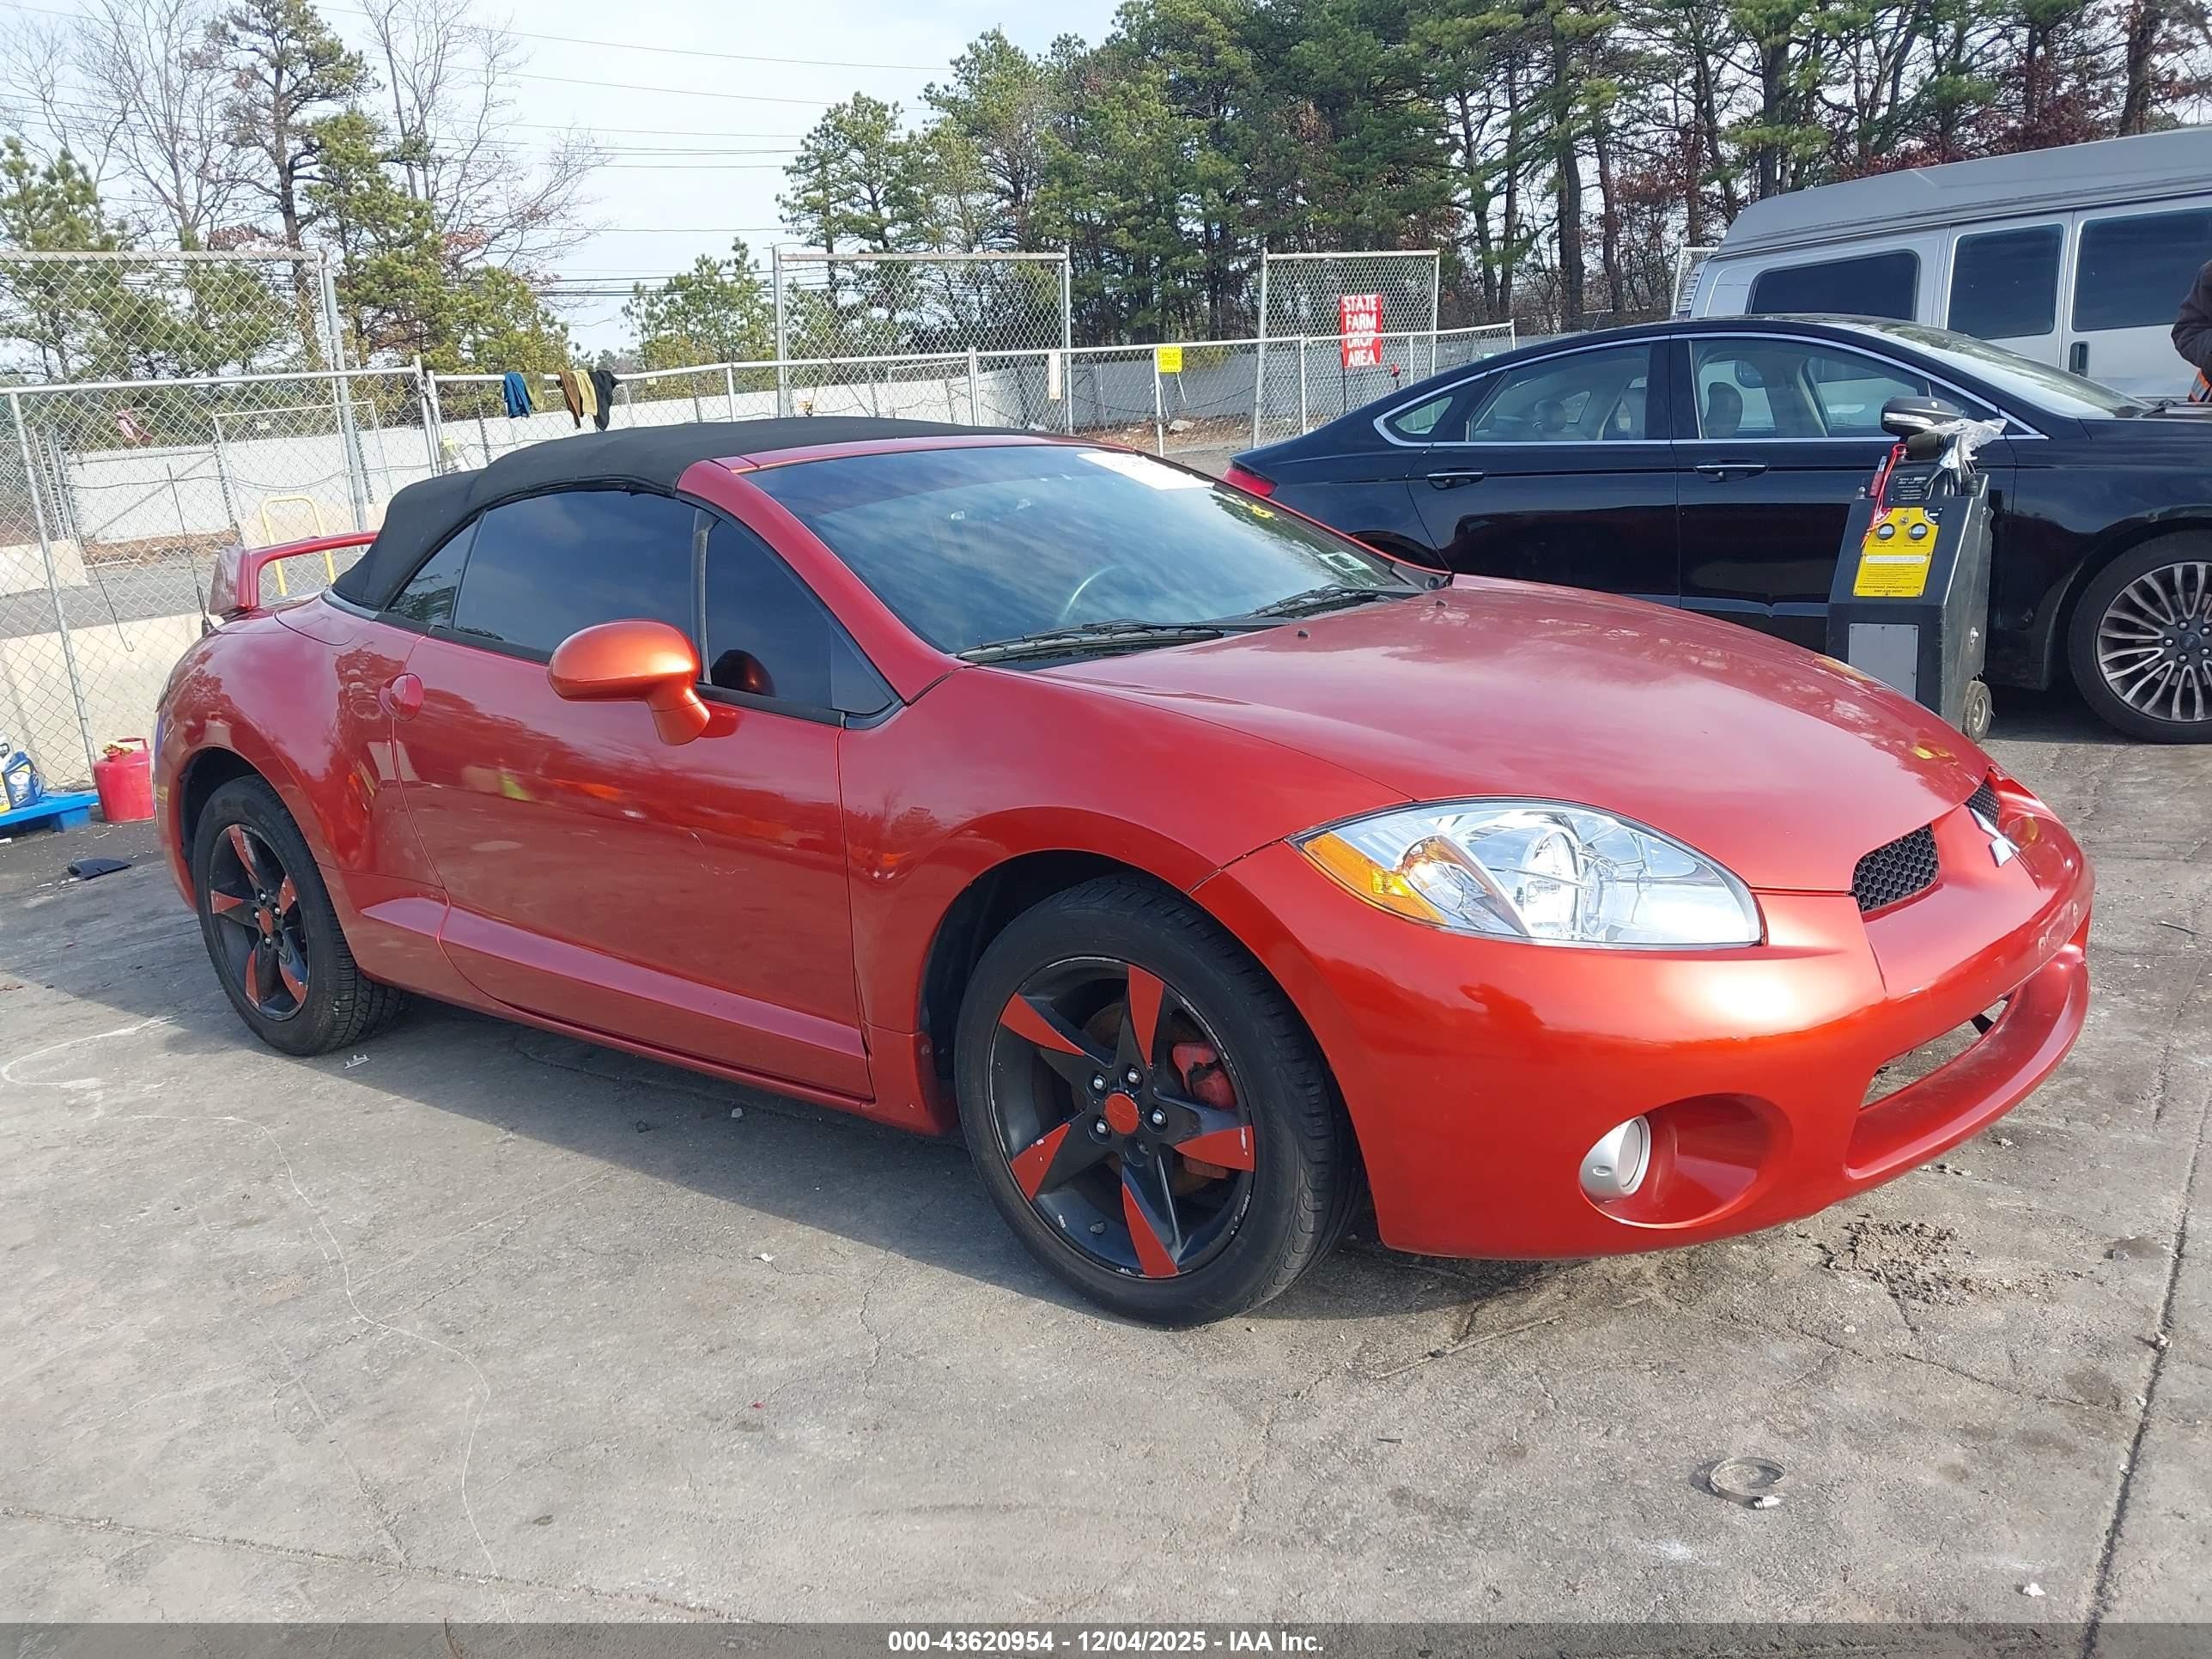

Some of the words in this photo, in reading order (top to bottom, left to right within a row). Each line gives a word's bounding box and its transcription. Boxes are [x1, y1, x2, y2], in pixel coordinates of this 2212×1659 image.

[1344, 295, 1377, 312] STATE
[1346, 313, 1376, 331] FARM
[1346, 331, 1376, 349] DROP
[1347, 349, 1376, 368] AREA
